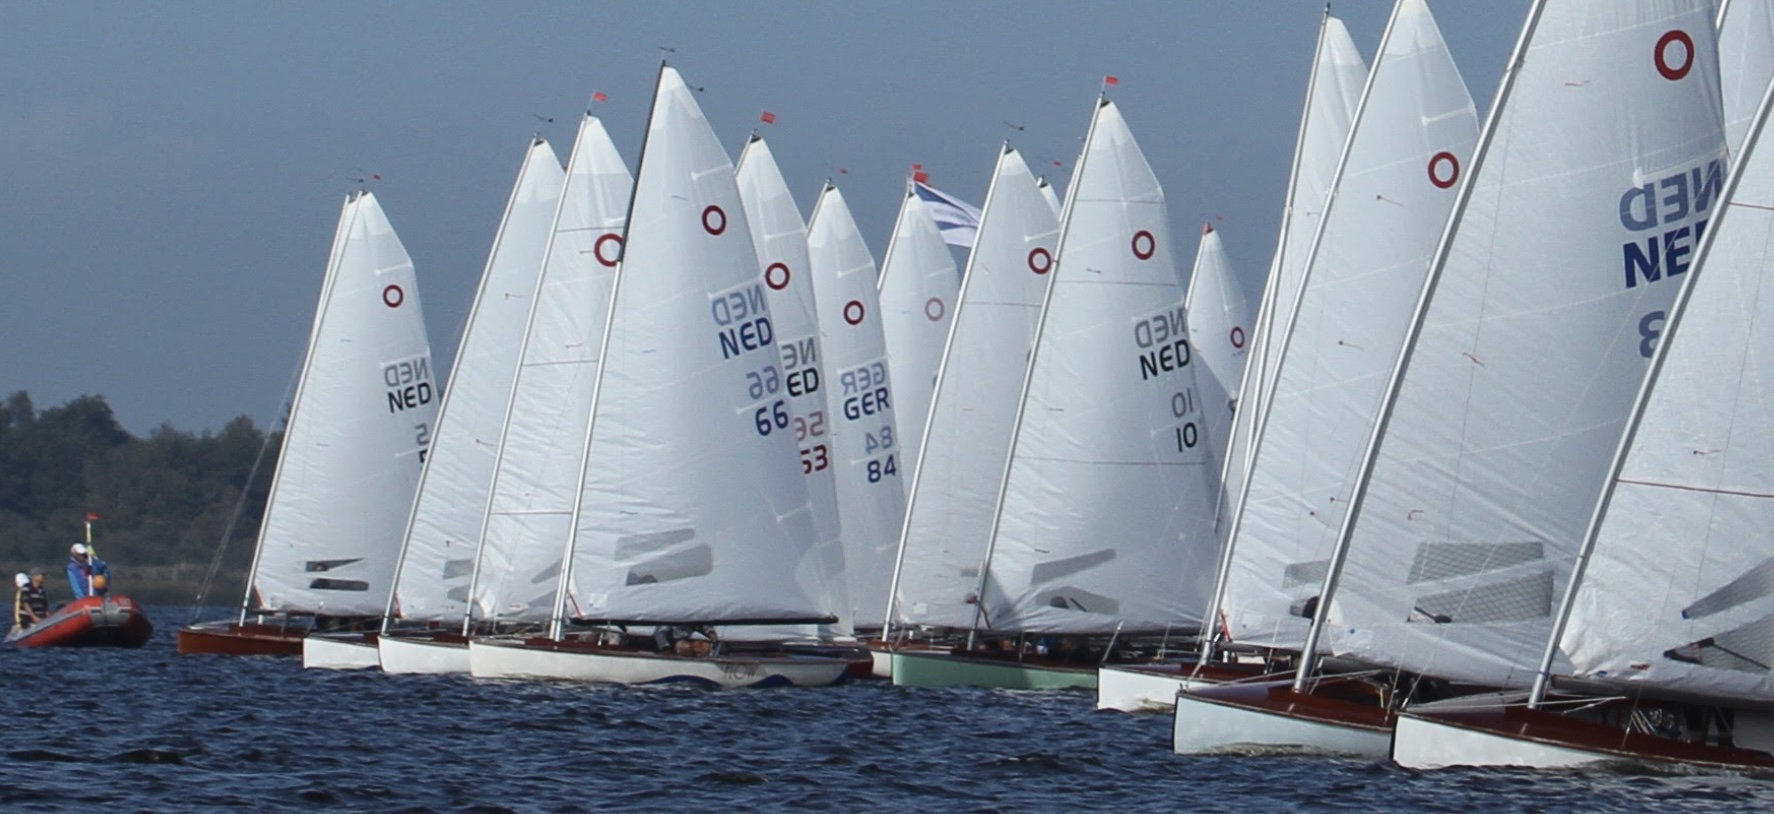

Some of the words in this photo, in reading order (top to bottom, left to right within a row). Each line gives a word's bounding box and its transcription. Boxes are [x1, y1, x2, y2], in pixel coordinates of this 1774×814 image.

[1623, 219, 1709, 288] NE
[718, 317, 773, 360] NED
[1139, 339, 1190, 380] NED
[387, 382, 432, 413] NED
[786, 367, 819, 397] ED
[755, 400, 789, 436] 66
[844, 387, 890, 421] GER
[1176, 422, 1198, 453] 10
[867, 454, 897, 484] 84
